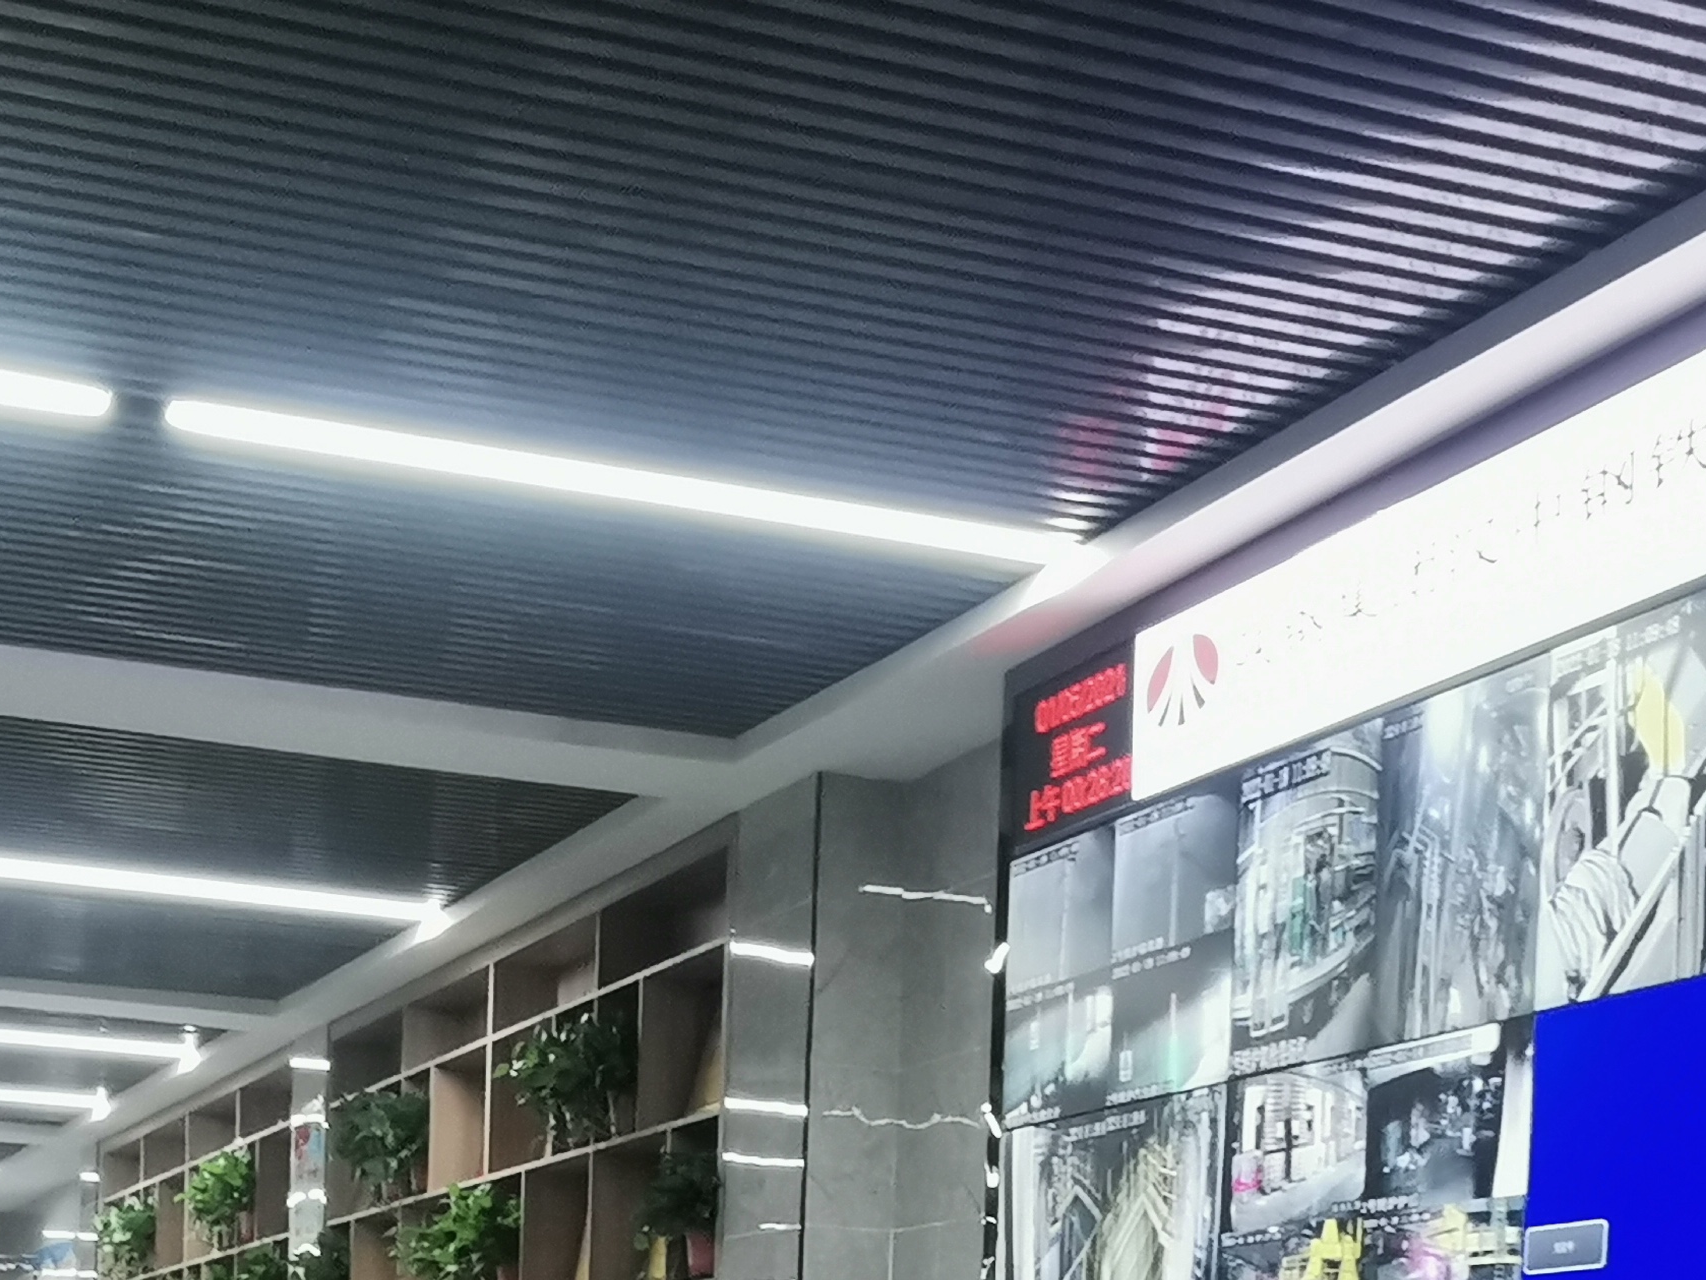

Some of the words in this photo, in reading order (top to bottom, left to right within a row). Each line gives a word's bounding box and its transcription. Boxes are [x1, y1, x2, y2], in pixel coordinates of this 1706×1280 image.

[1050, 721, 1107, 779] 星期二
[1023, 784, 1061, 831] 上午
